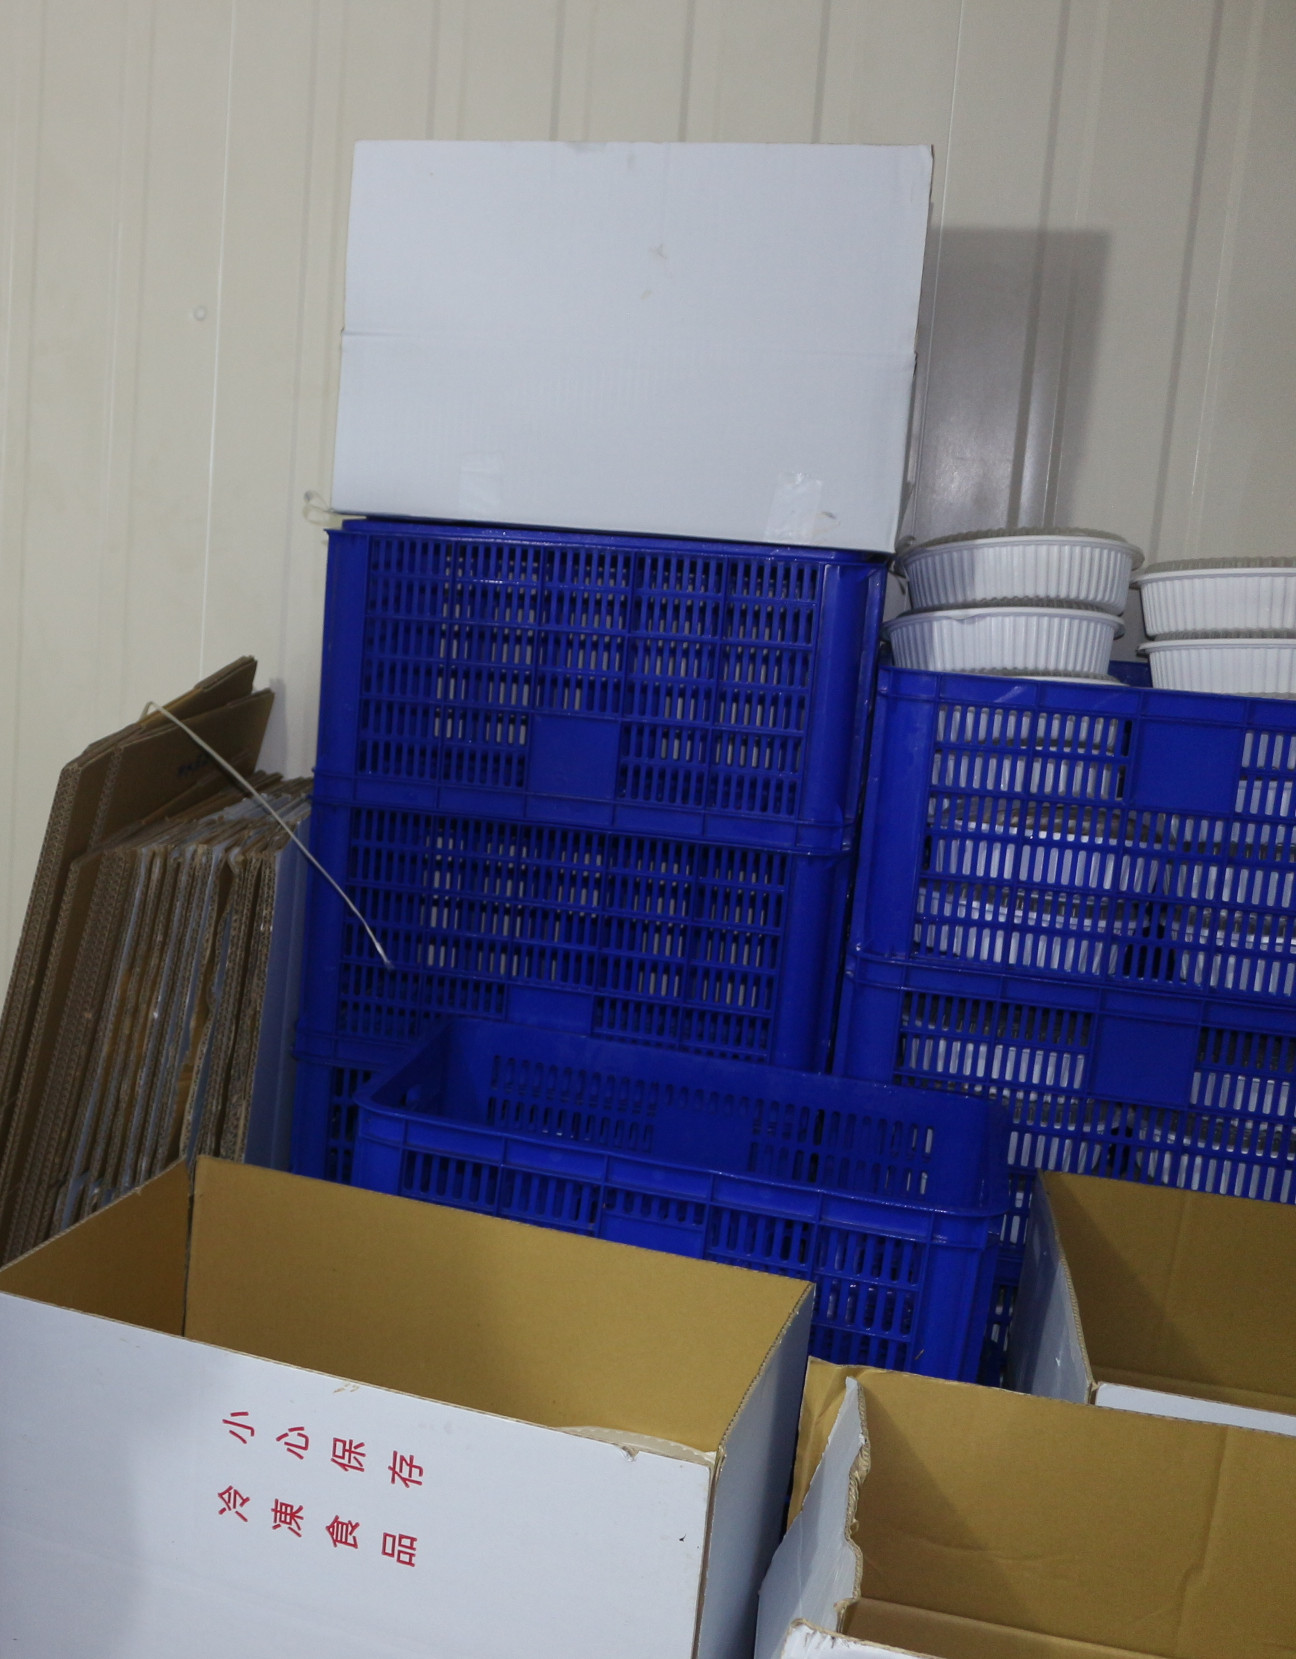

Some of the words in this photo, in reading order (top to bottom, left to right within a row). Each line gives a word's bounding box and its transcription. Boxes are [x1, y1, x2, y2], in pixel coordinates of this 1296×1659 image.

[221, 1411, 424, 1488] 小心保存
[217, 1485, 418, 1568] 冷凍食品
